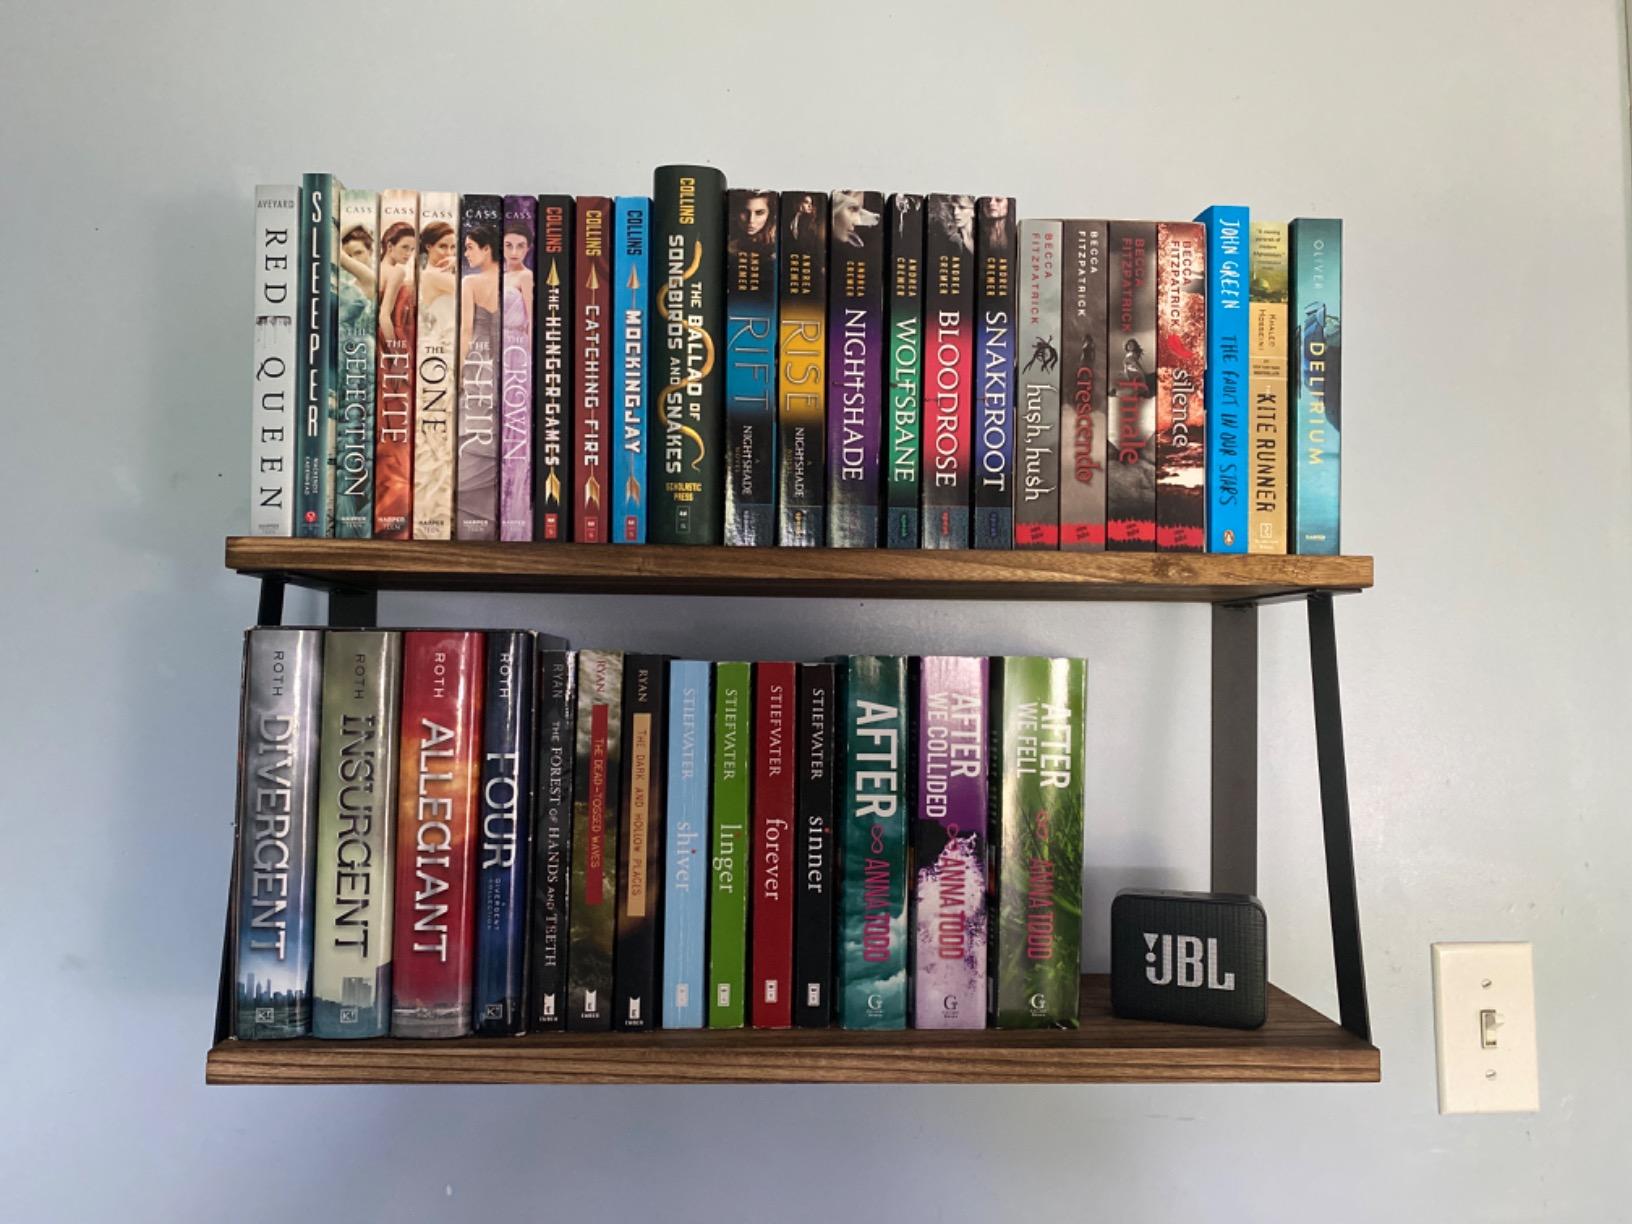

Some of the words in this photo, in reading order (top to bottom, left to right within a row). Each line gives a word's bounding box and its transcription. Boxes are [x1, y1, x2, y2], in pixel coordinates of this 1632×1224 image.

[257, 200, 295, 209] AVEYARD
[384, 207, 415, 215] CASS
[466, 210, 497, 219] CASS
[679, 178, 694, 224] COLLINS
[546, 207, 562, 253] COLLINS
[586, 210, 602, 257] COLLINS
[627, 210, 643, 256] COLLINS
[1090, 231, 1098, 274] BECCA
[1219, 218, 1240, 255] JOHN
[264, 228, 287, 304] RED
[738, 252, 747, 291] CREMER
[750, 252, 759, 291] ANDREA
[790, 254, 799, 294] CREMER
[802, 255, 811, 294] ANDREA
[846, 260, 855, 298] CREMER
[856, 261, 865, 298] ANDREA
[897, 257, 906, 298] CREMER
[908, 258, 917, 298] ANDREA
[939, 255, 949, 295] CREMER
[951, 256, 960, 295] ANDREA
[986, 257, 996, 297] CREMER
[999, 258, 1008, 297] ANDREA
[1031, 232, 1041, 325] FITZPATRICK
[1044, 232, 1053, 278] BECCA
[1077, 231, 1086, 317] FITZPATRICK
[1135, 238, 1145, 287] BECCA
[1183, 241, 1192, 285] BECCA
[1312, 240, 1324, 289] OLIVER
[548, 289, 559, 311] THE
[668, 235, 684, 349] SONGBIRDS
[691, 282, 702, 307] THE
[1122, 237, 1133, 332] FITZPATRICK
[1170, 241, 1180, 327] FITZPATRICK
[1220, 260, 1240, 309] GREEN
[308, 191, 322, 436] SLEEPER
[424, 346, 444, 354] THE
[468, 341, 491, 349] THE
[545, 317, 561, 397] HUNGER
[585, 305, 599, 408] CATCHING
[688, 315, 703, 396] BALLAD
[728, 315, 770, 412] RIFT
[782, 319, 821, 412] RISE
[1221, 336, 1238, 361] THE
[624, 310, 641, 454] MOCKINGJAY
[670, 357, 680, 384] AND
[841, 308, 867, 481] NIGHTSHADE
[1221, 371, 1239, 405] FAULT
[343, 341, 368, 497] SELECTION
[381, 353, 409, 442] ELITE
[419, 356, 448, 436] ONE
[458, 352, 494, 458] HEIR
[502, 344, 528, 462] CROWN
[689, 402, 700, 421] OF
[894, 317, 918, 482] WOLFSBANE
[935, 310, 960, 488] BLOODROSE
[983, 311, 1008, 492] SNAKEROOT
[1022, 383, 1056, 444] hush,
[1171, 367, 1195, 447] silence
[1221, 413, 1237, 428] IN
[1255, 394, 1277, 432] KITE
[1308, 342, 1325, 466] DELIRIUM
[257, 357, 286, 510] QUEEN
[545, 403, 560, 466] GAMES
[584, 419, 598, 466] FIRE
[666, 393, 682, 474] SNAKES
[1074, 367, 1102, 487] crescendo
[1118, 378, 1147, 465] finale
[1220, 432, 1237, 457] OUR
[742, 425, 753, 495] NIGHTSHADE
[794, 427, 805, 498] NIGHTSHADE
[1024, 447, 1056, 502] hush
[1255, 439, 1277, 513] RUNNER
[1220, 465, 1237, 506] STARS
[272, 651, 284, 696] ROTH
[354, 655, 364, 699] ROTH
[434, 653, 446, 698] ROTH
[499, 653, 510, 698] ROTH
[552, 664, 563, 698] RYAN
[595, 660, 606, 692] RYAN
[637, 669, 649, 702] RYAN
[551, 721, 560, 742] THE
[769, 685, 782, 776] STIEFVATER
[928, 692, 948, 722] WE
[1017, 702, 1037, 730] WE
[593, 738, 604, 756] THE
[636, 730, 645, 747] THE
[682, 688, 695, 780] STIEFVATER
[724, 689, 737, 780] STIEFVATER
[810, 688, 824, 780] STIEFVATER
[856, 700, 898, 817] AFTER
[950, 692, 980, 777] AFTER
[1016, 737, 1037, 778] FELL
[1040, 703, 1072, 788] AFTER
[549, 747, 562, 805] FOREST
[635, 754, 645, 778] DARK
[926, 726, 947, 817] COLLIDED
[483, 752, 519, 868] FOUR
[549, 809, 558, 822] OF
[592, 759, 603, 832] DEAD-TOSSED
[634, 788, 644, 807] AND
[250, 713, 297, 960] DIVERGENT
[334, 714, 375, 957] INSURGENT
[413, 719, 454, 962] ALLEGIANT
[547, 828, 559, 883] HANDS
[590, 836, 600, 868] WAVES
[633, 814, 643, 853] HOLLOW
[675, 822, 698, 892] shiver
[713, 823, 742, 893] linger
[808, 816, 830, 893] sinner
[631, 858, 642, 895] PLACES
[764, 818, 787, 900] forever
[864, 858, 890, 909] ANNA
[940, 856, 966, 908] ANNA
[1028, 857, 1053, 908] ANNA
[546, 887, 554, 910] AND
[544, 914, 557, 966] TEETH
[863, 913, 890, 962] TODD
[939, 912, 965, 959] TODD
[1027, 913, 1053, 959] TODD
[1143, 933, 1236, 991] JBL
